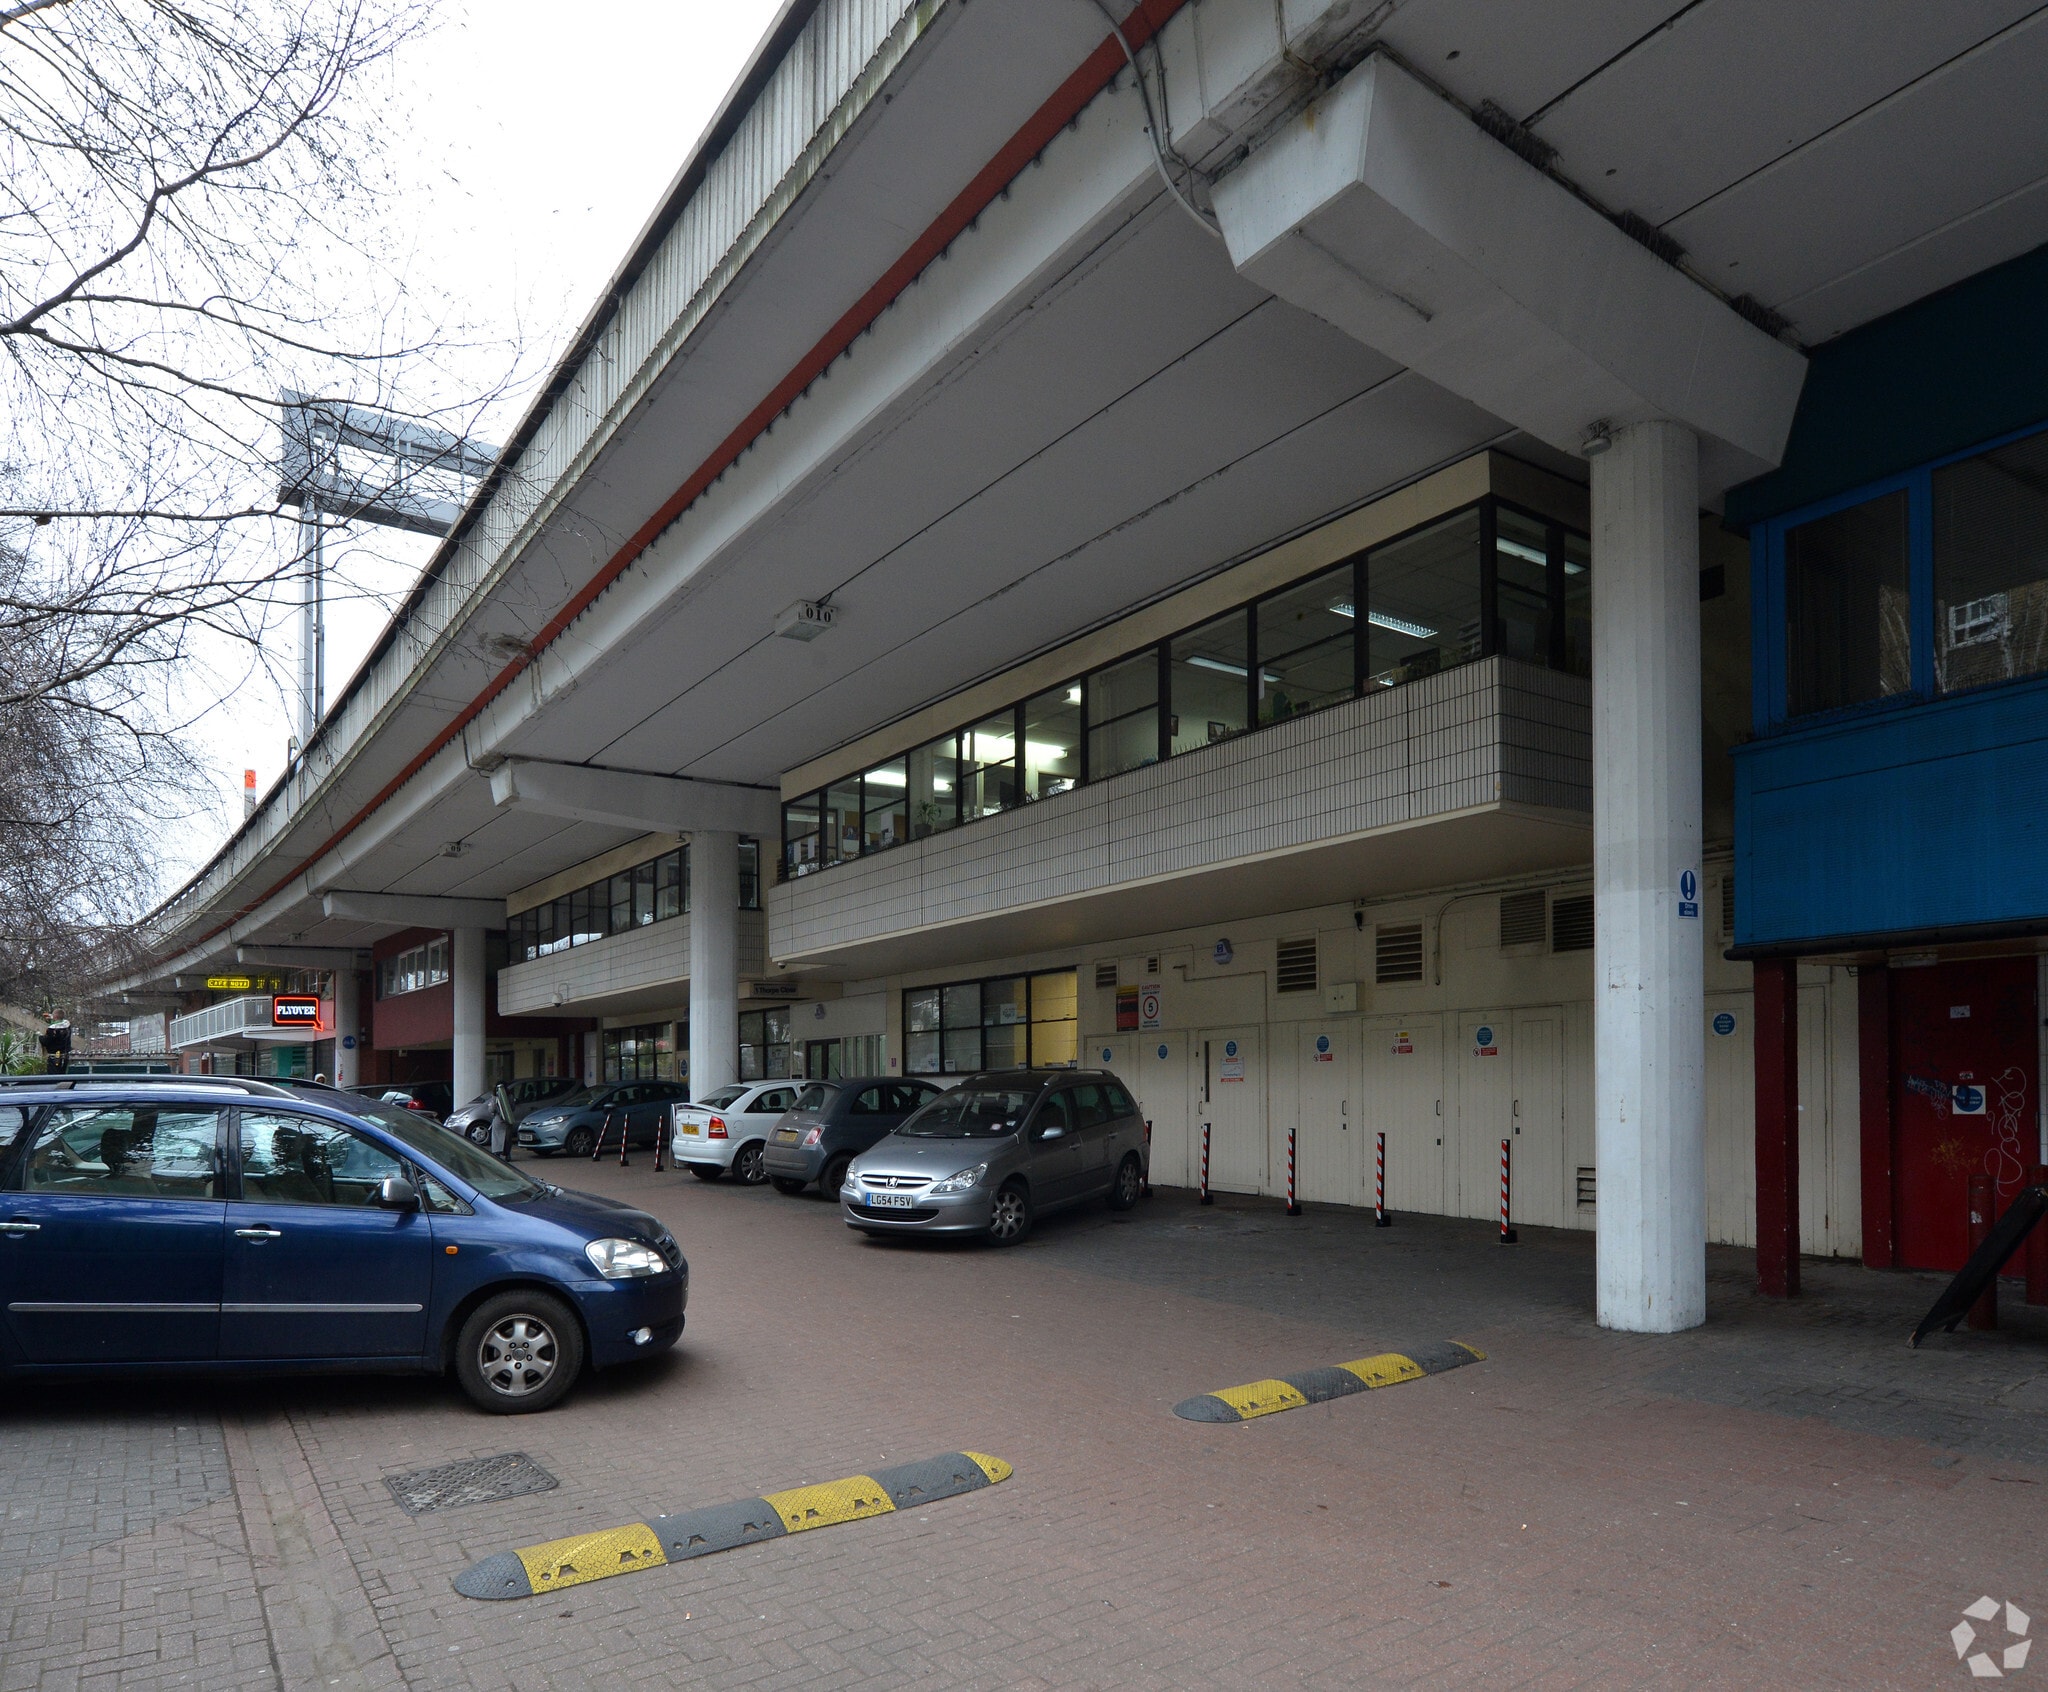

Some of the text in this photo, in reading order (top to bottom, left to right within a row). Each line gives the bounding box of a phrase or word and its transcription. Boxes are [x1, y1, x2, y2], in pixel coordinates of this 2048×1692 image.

[806, 607, 831, 623] 010
[277, 1005, 316, 1015] FLYOVER
[1148, 1002, 1154, 1012] 5
[871, 1195, 911, 1206] LG54 FSV
